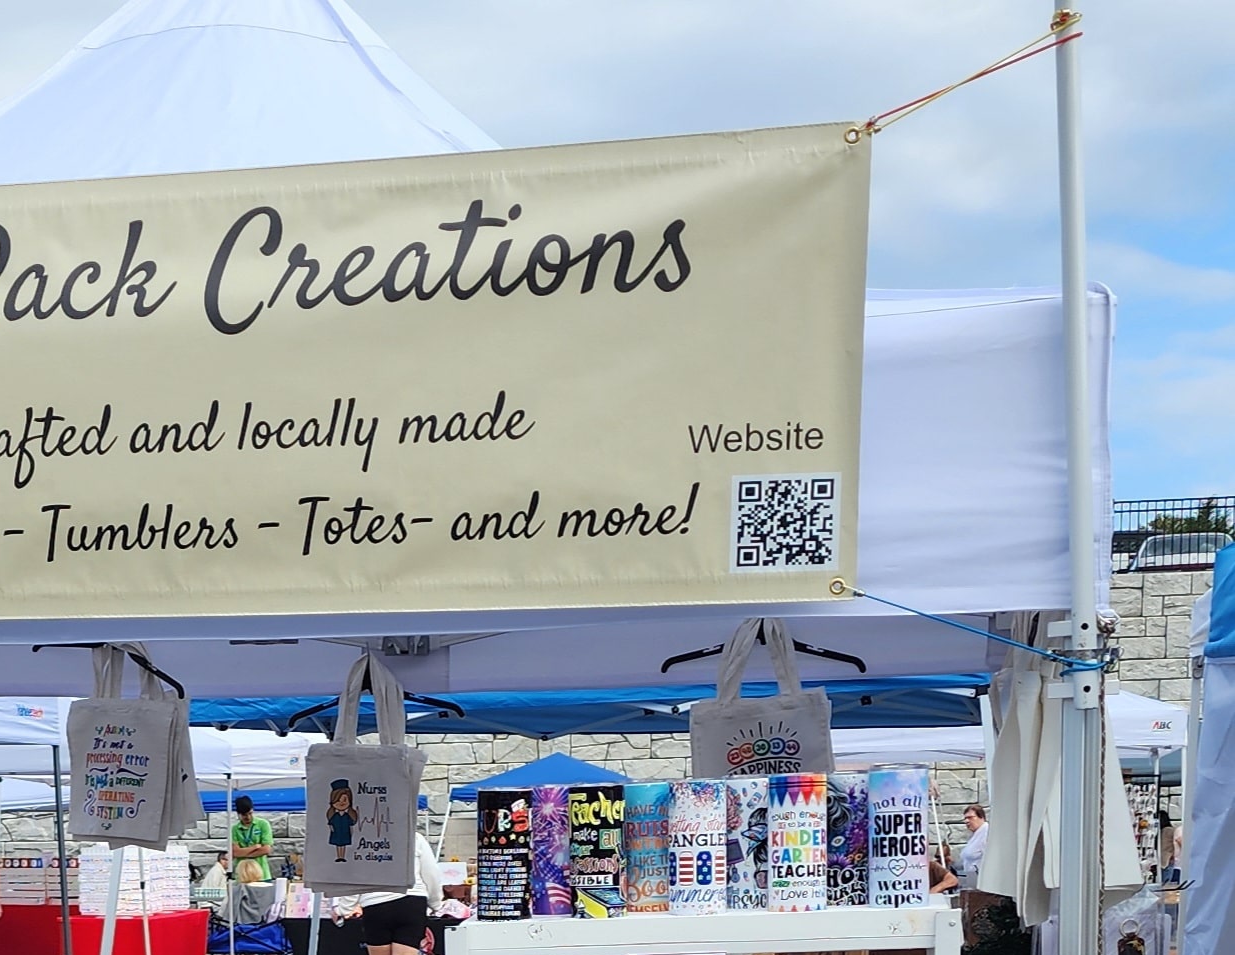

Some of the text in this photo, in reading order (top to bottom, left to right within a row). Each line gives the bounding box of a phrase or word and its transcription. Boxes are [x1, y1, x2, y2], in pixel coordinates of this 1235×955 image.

[203, 199, 692, 337] Creations
[129, 399, 226, 454] and
[237, 397, 379, 473] locally
[398, 390, 536, 446] made
[688, 422, 825, 454] Website
[41, 502, 239, 563] Tumblers
[450, 490, 546, 542] and
[557, 481, 701, 538] more!
[1153, 721, 1172, 730] ABC
[125, 754, 150, 767] error
[729, 760, 801, 777] APPINESS
[873, 796, 922, 811] not all
[874, 813, 922, 835] SUPER
[357, 837, 390, 851] Angels
[872, 835, 926, 857] HEROES
[354, 852, 362, 861] in
[878, 878, 922, 891] wear
[780, 889, 808, 901] Love
[875, 892, 923, 909] capes
